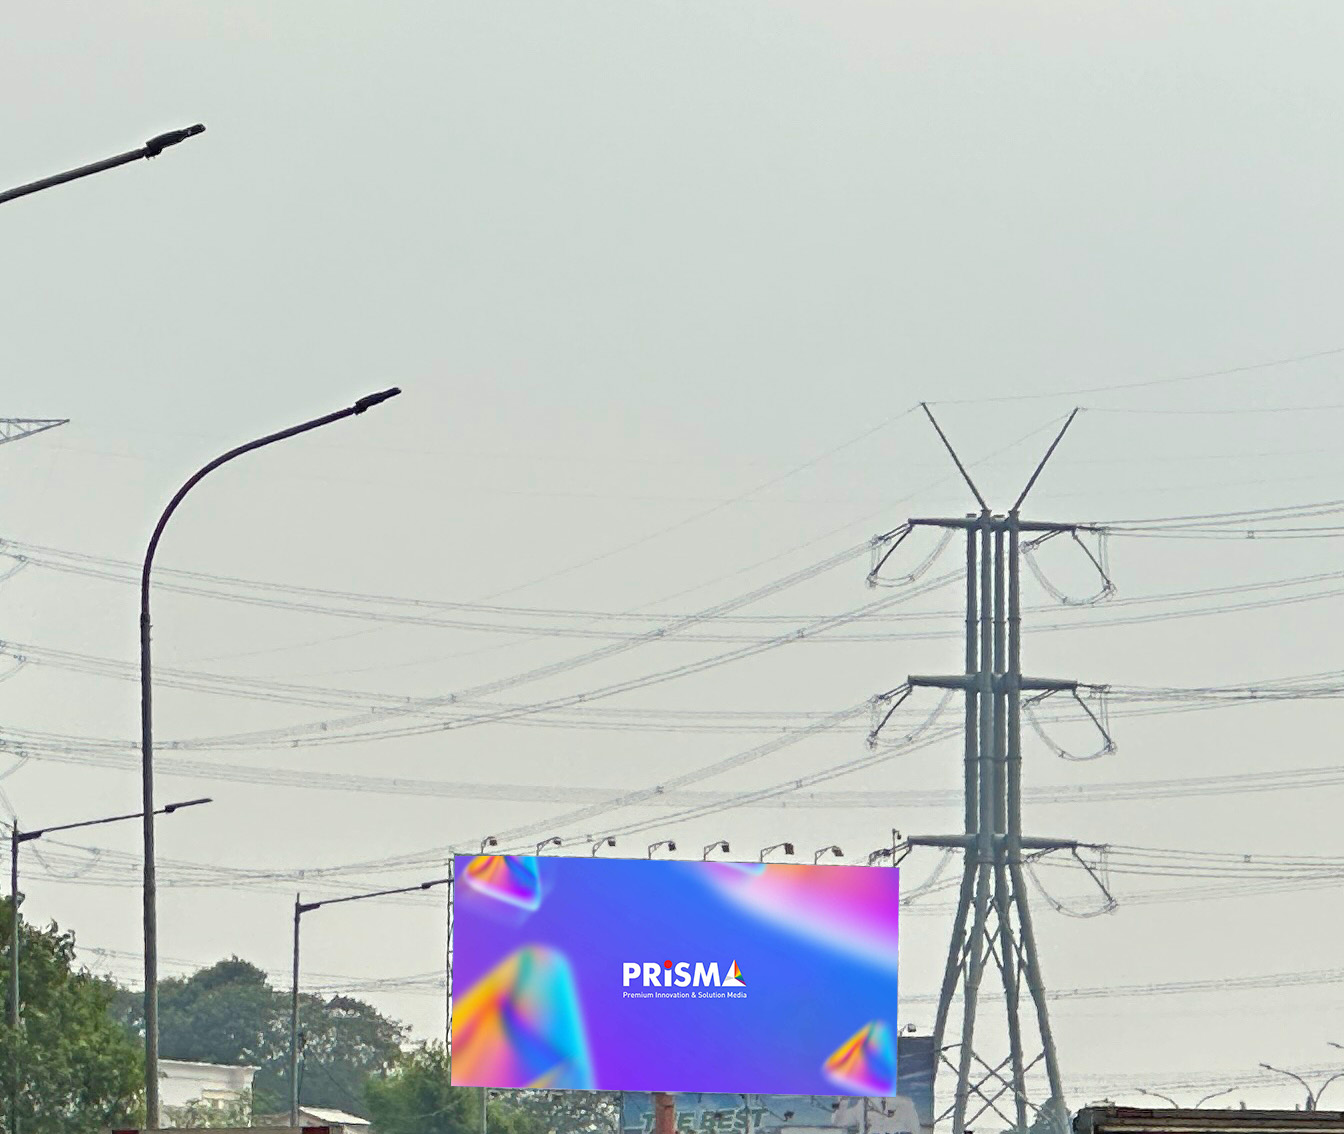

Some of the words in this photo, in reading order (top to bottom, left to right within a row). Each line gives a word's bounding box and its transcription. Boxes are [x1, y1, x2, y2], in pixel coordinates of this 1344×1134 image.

[622, 991, 654, 999] Premium
[655, 991, 690, 999] Innovation
[691, 991, 697, 999] &
[698, 991, 726, 999] Solution
[727, 991, 748, 999] Media
[640, 1110, 695, 1134] TE
